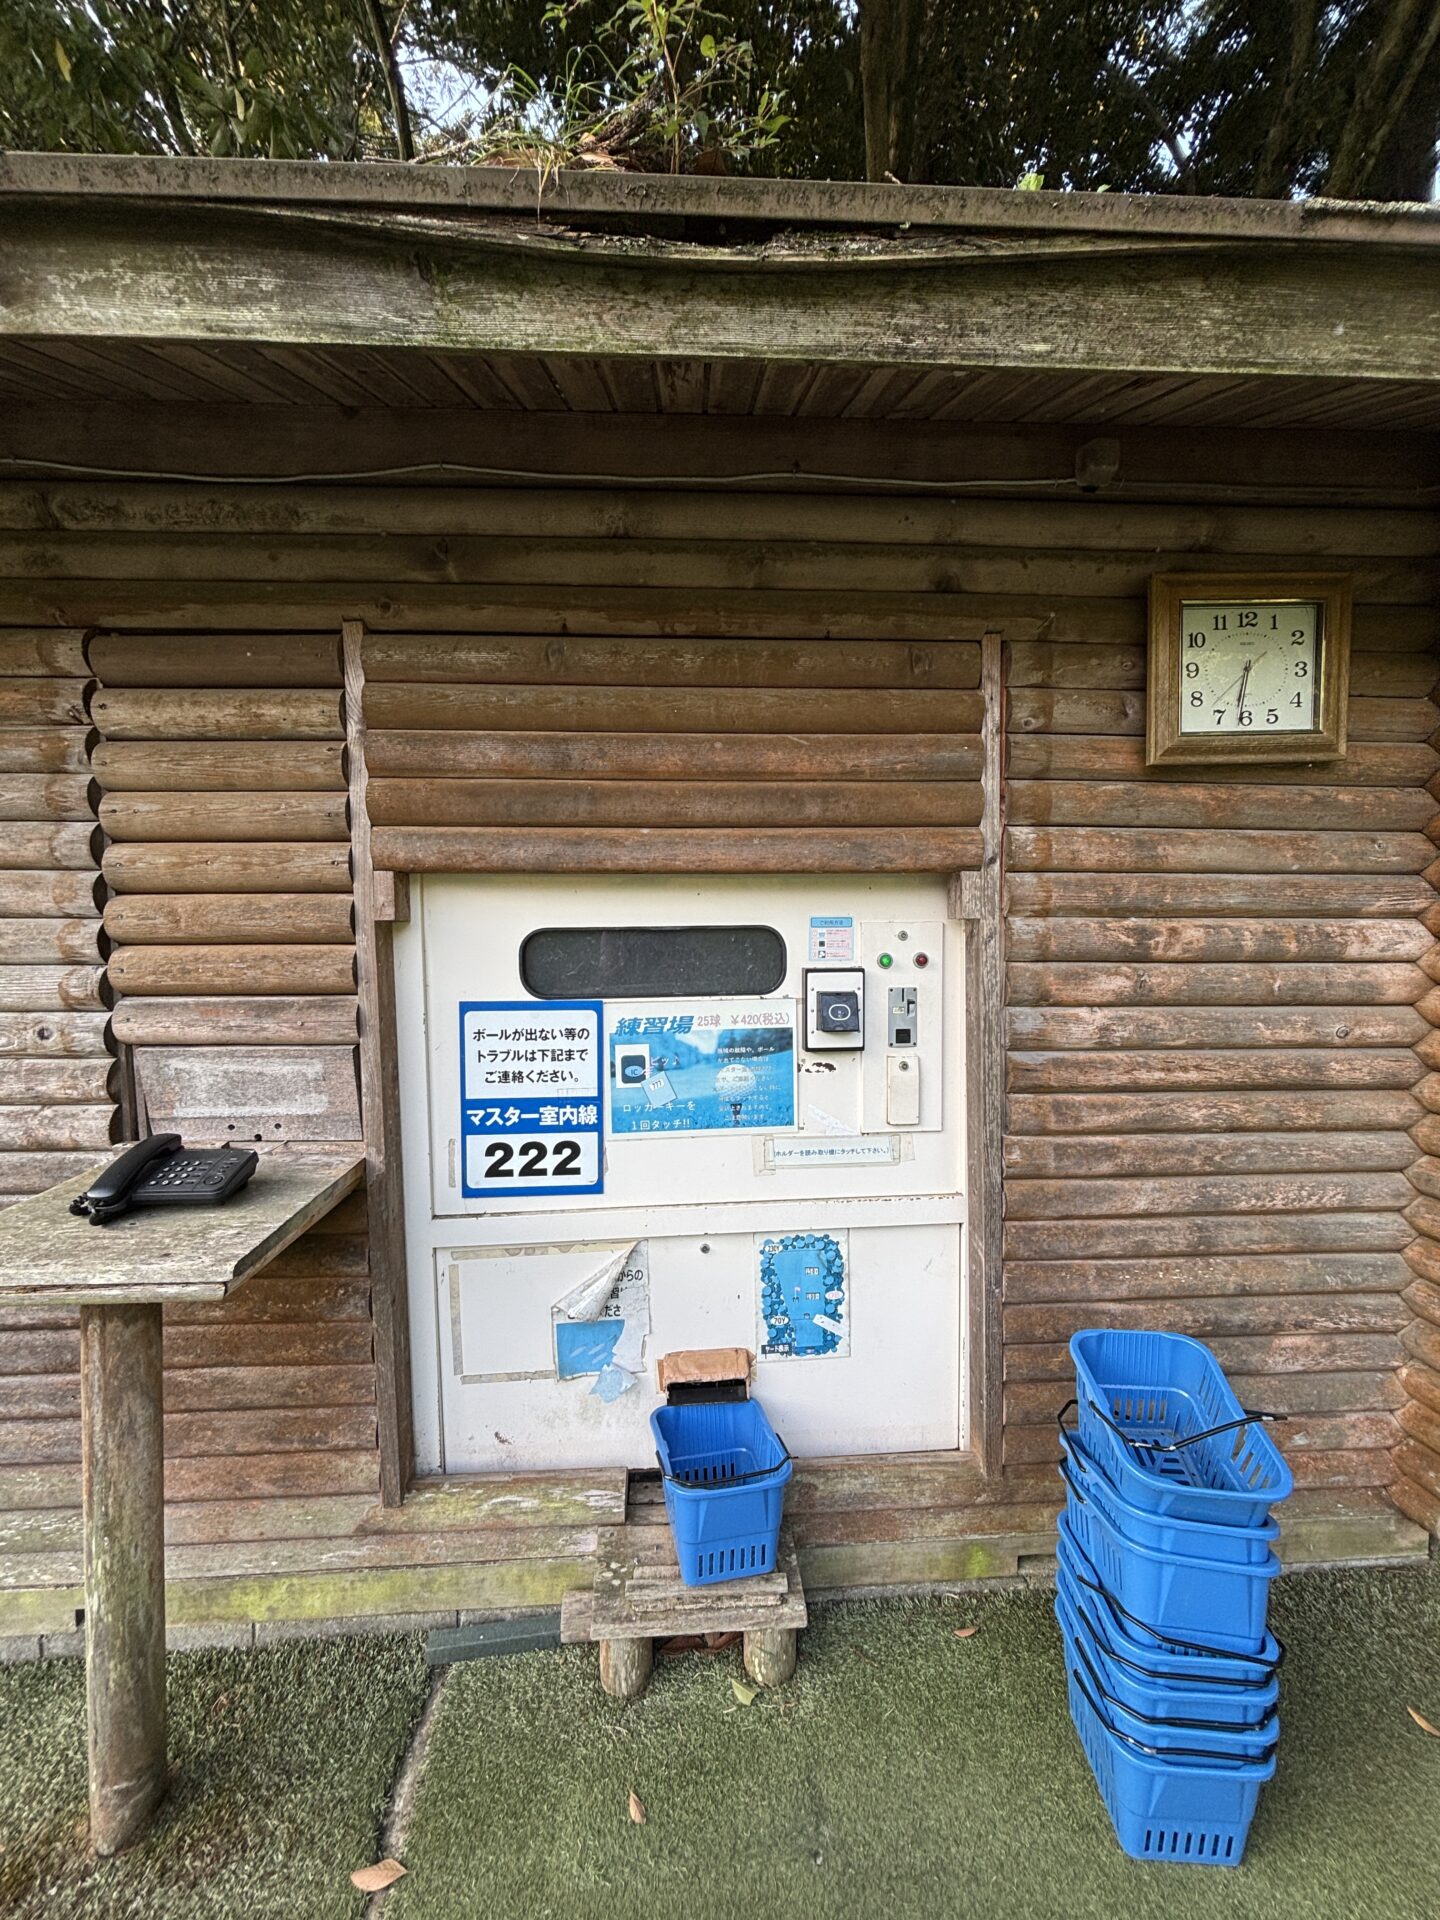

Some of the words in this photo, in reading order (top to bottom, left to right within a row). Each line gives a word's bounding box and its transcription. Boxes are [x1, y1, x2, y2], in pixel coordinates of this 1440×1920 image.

[1212, 614, 1228, 631] 11
[1237, 611, 1259, 628] 12
[1269, 613, 1280, 630] 1
[1187, 631, 1206, 649] 10
[1291, 629, 1305, 646] 2
[1185, 661, 1200, 679] 9
[1294, 660, 1308, 678] 3
[1190, 690, 1203, 708] 8
[1289, 691, 1302, 708] 4
[1212, 708, 1227, 726] 7
[1240, 710, 1253, 727] 6
[1265, 708, 1279, 725] 5
[614, 1015, 695, 1036] 練習場
[697, 1014, 721, 1027] 25球
[472, 1028, 590, 1042] ボールが出ない等の
[477, 1048, 590, 1063] トラブルは下記まで
[484, 1070, 580, 1084] ご連絡ください。
[630, 1068, 639, 1076] IC
[623, 1101, 697, 1113] ロッカーキーを
[466, 1105, 599, 1127] マスター室内線
[484, 1140, 582, 1178] 222
[774, 1317, 786, 1325] 70Y
